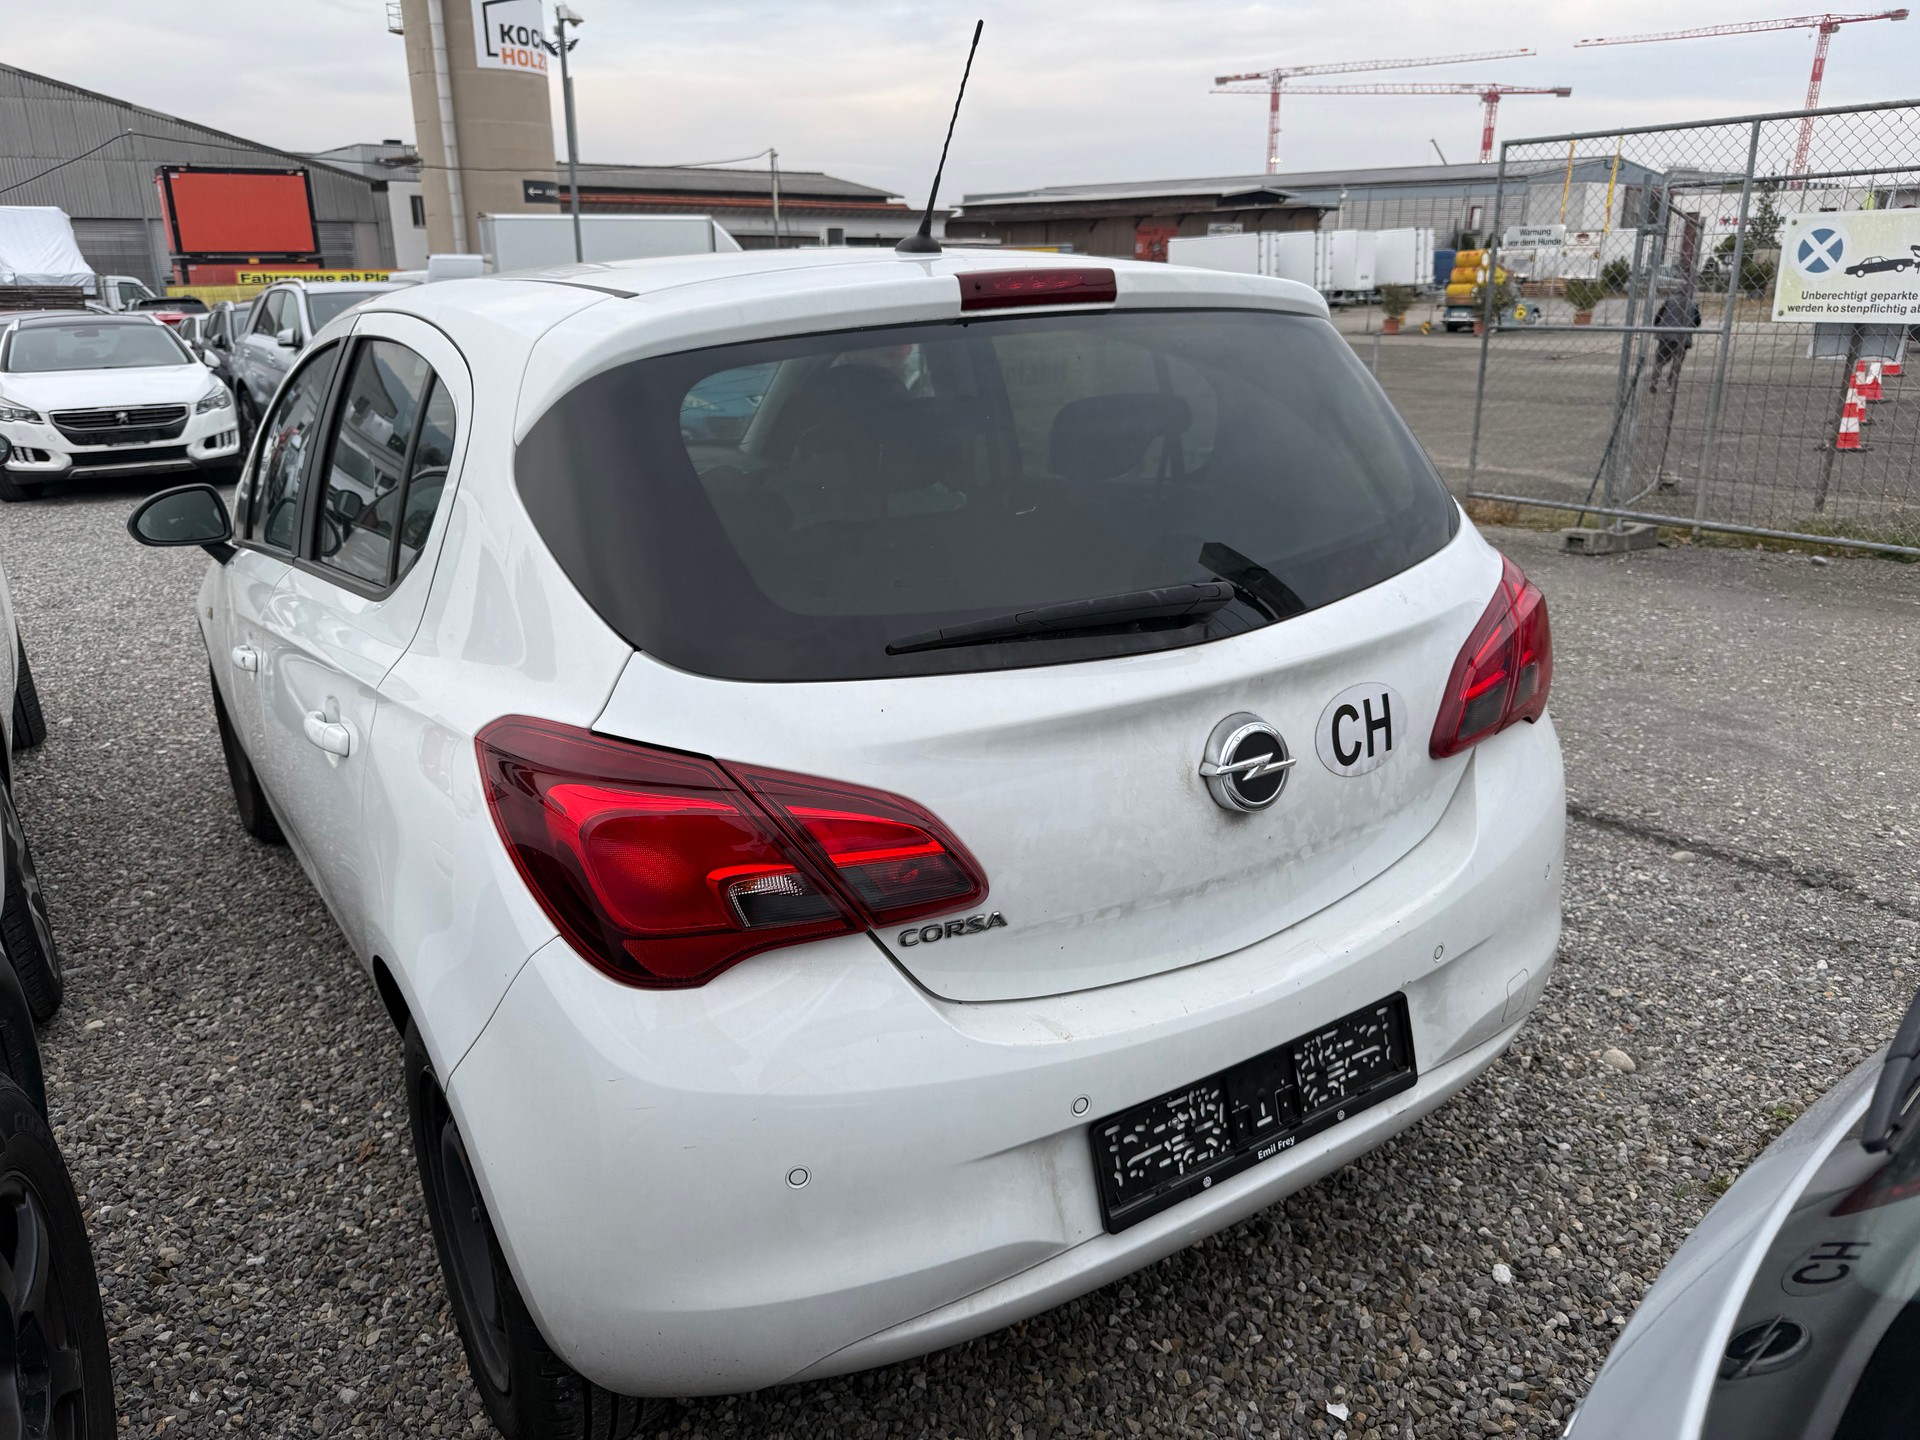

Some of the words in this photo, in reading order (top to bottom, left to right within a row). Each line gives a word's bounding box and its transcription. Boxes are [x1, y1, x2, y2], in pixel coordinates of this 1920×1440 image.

[499, 23, 543, 49] KOC
[1520, 228, 1551, 237] Warnung
[1538, 238, 1562, 246] Hunde
[341, 273, 360, 283] ab
[1801, 290, 1868, 302] Unberechtigt
[1870, 291, 1919, 303] geparkte
[1787, 304, 1824, 313] werden
[1331, 692, 1392, 767] CH
[898, 910, 1008, 947] CORSA
[1257, 1143, 1276, 1160] Emil
[1277, 1136, 1295, 1150] Frey
